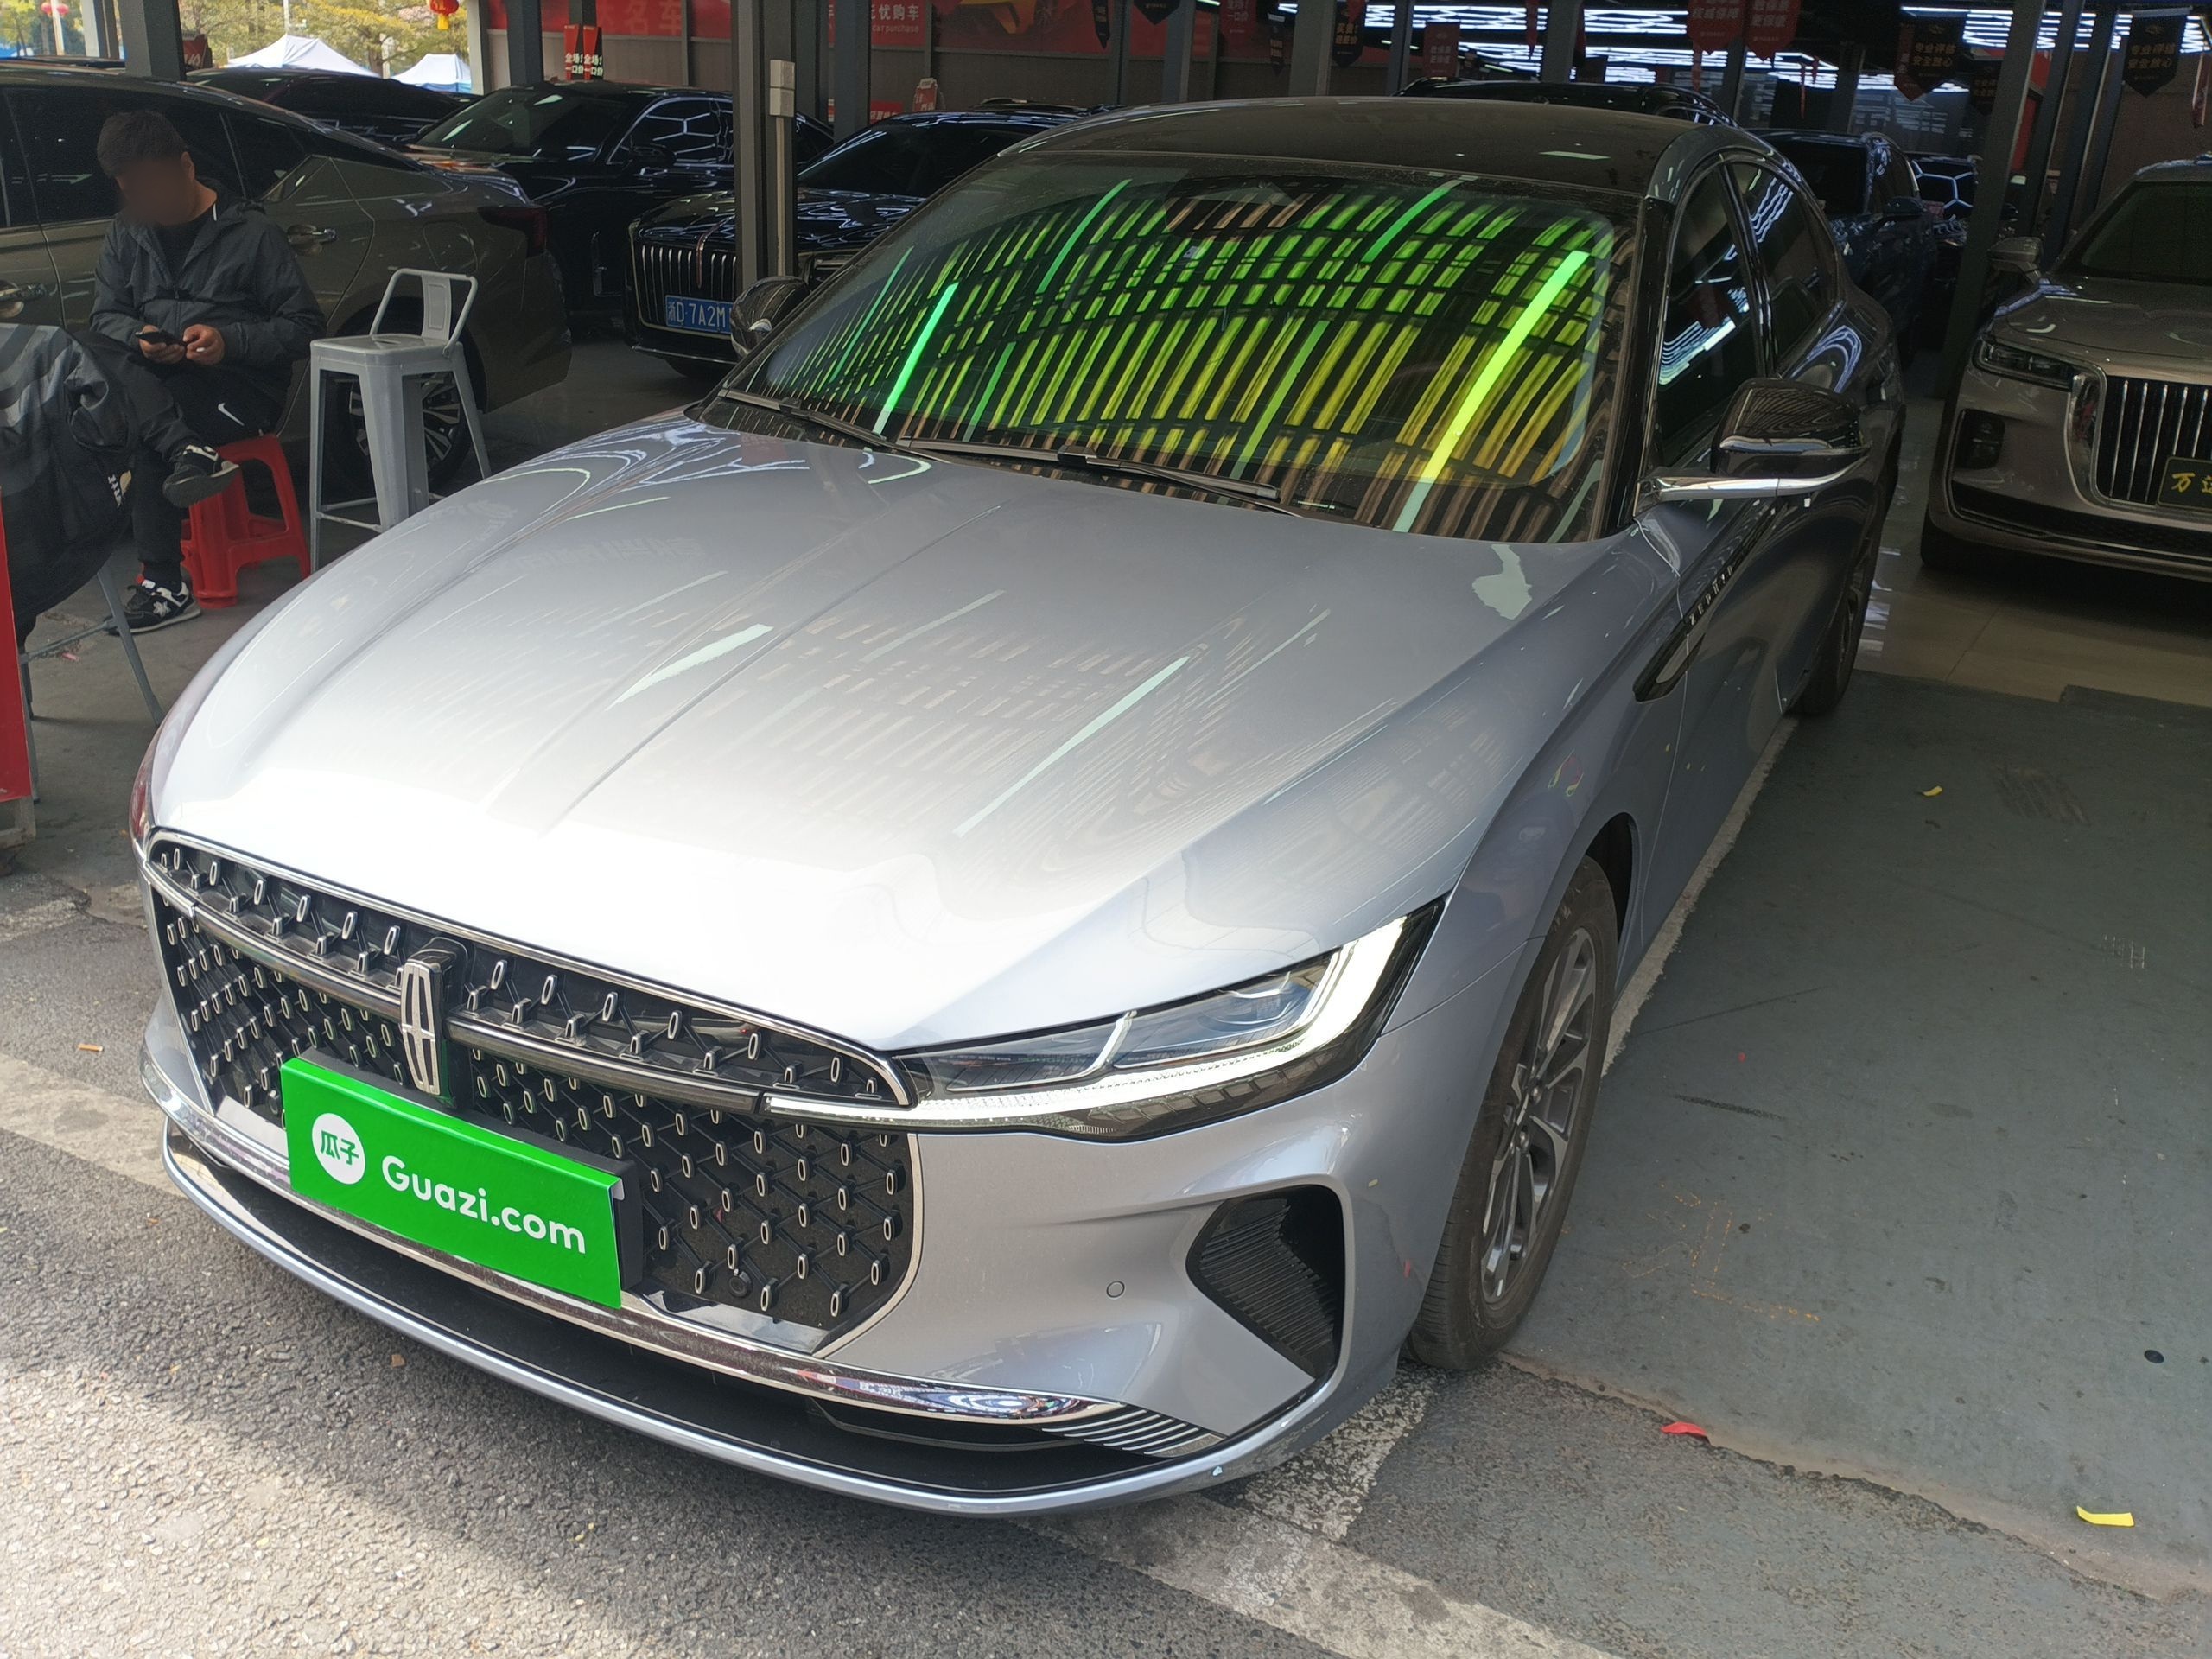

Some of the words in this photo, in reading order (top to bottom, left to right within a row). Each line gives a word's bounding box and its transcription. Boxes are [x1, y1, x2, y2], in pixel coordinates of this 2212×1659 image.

[668, 300, 732, 329] 浙D·7A2M
[320, 1129, 359, 1166] 瓜子
[381, 1154, 586, 1254] Guazi.com
